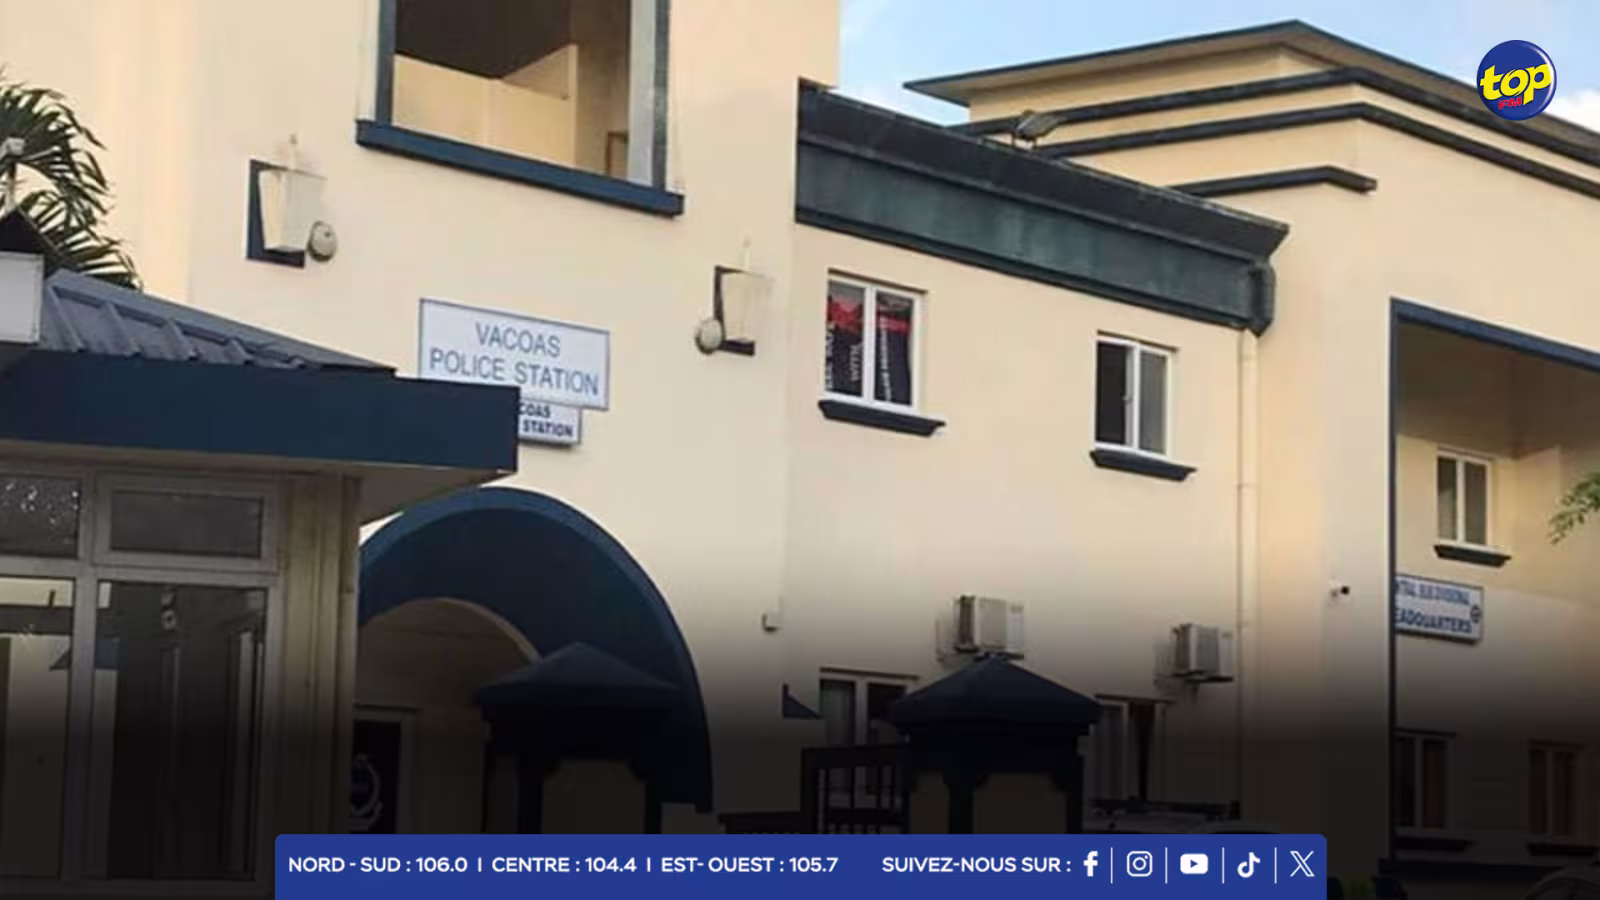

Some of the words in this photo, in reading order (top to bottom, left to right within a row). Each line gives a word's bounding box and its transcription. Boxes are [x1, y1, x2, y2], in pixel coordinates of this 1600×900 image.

[476, 322, 561, 358] VACOAS
[429, 347, 505, 381] POLICE
[514, 361, 600, 396] STATION
[522, 419, 573, 438] STATION
